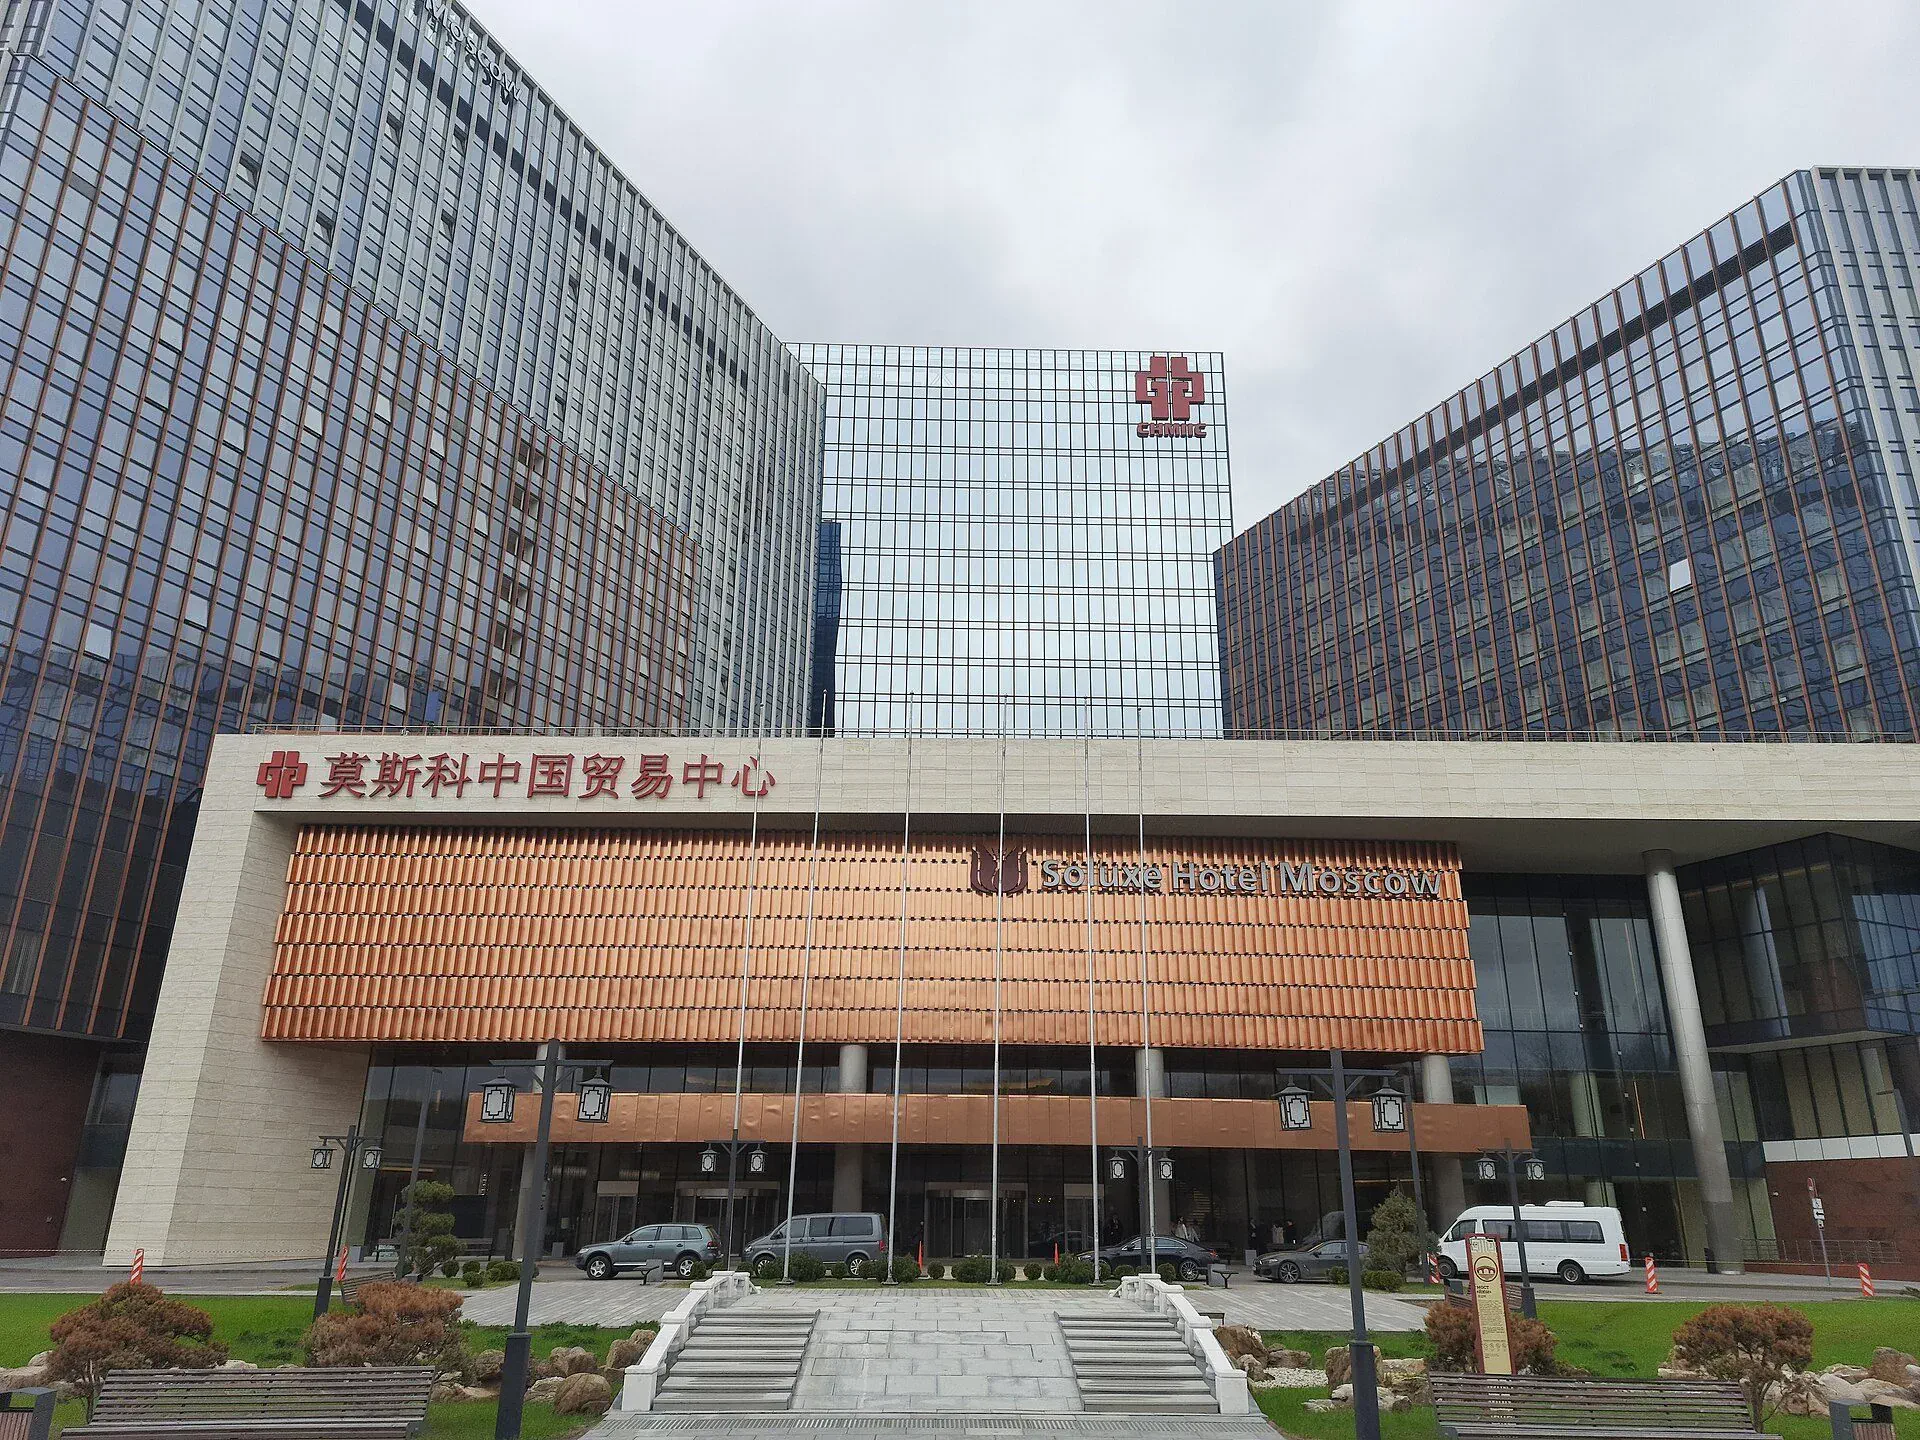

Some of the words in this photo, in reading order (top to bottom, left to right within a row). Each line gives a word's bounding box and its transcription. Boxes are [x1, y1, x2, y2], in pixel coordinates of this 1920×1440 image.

[317, 751, 776, 798] 莫斯科中国贸易中心
[1041, 857, 1162, 889] Soluxe
[1172, 860, 1268, 891] Hotel
[1279, 861, 1441, 895] Moscow
